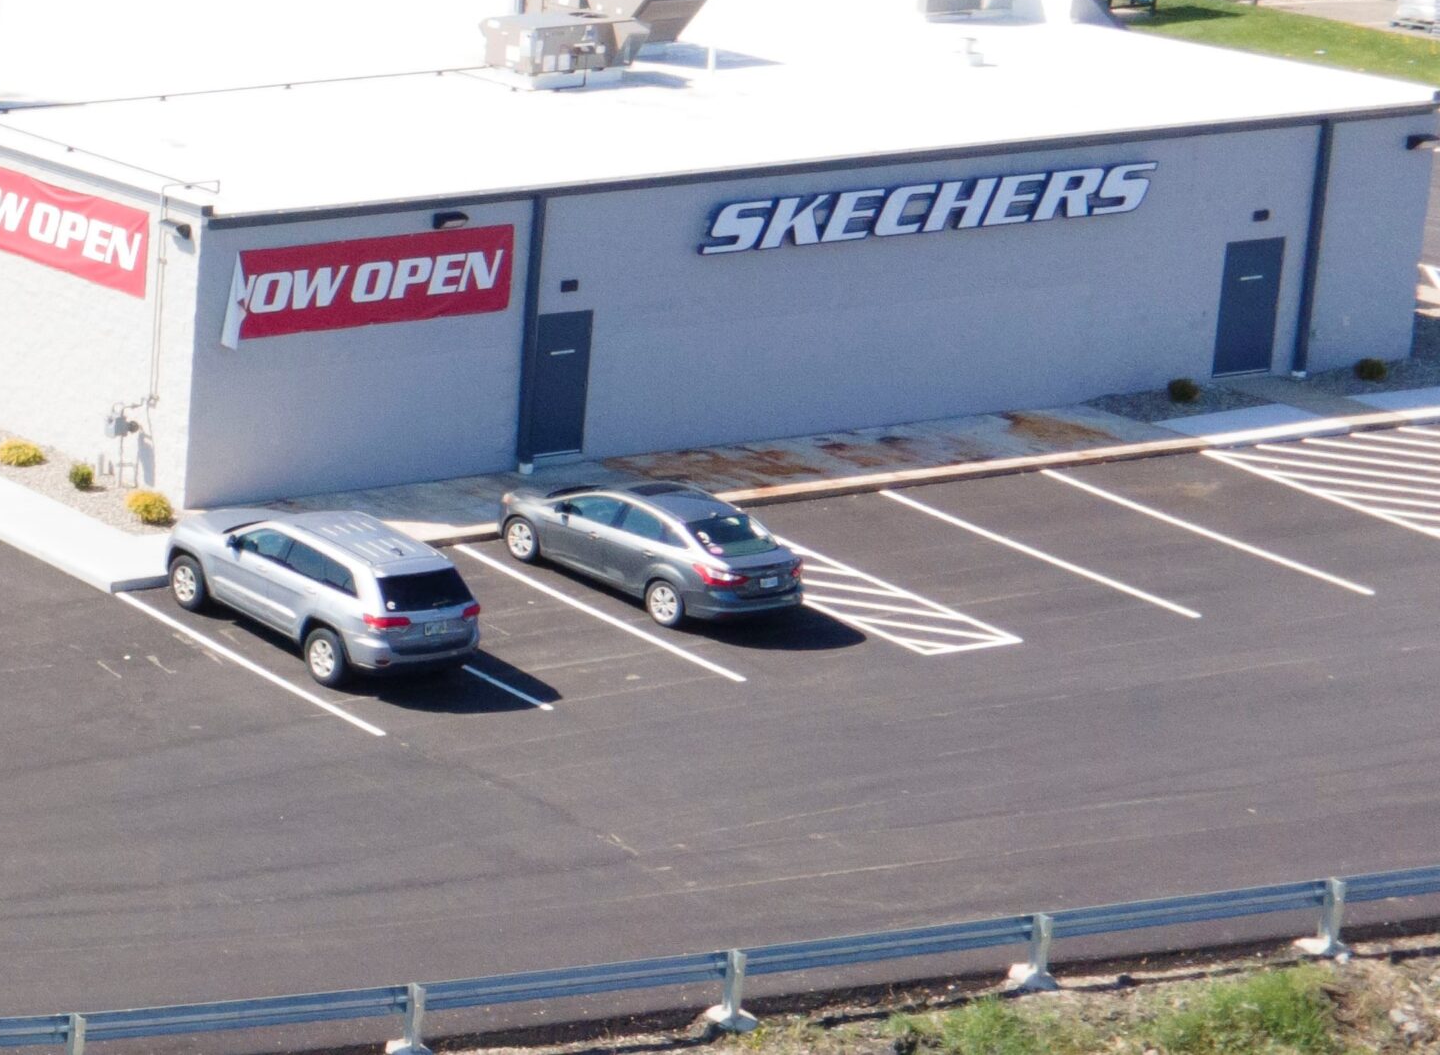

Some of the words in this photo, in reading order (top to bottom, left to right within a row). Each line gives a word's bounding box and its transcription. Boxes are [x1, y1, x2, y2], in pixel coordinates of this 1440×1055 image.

[27, 202, 143, 272] OPEN
[698, 161, 1158, 255] SKECHERS
[350, 249, 504, 303] OPEN
